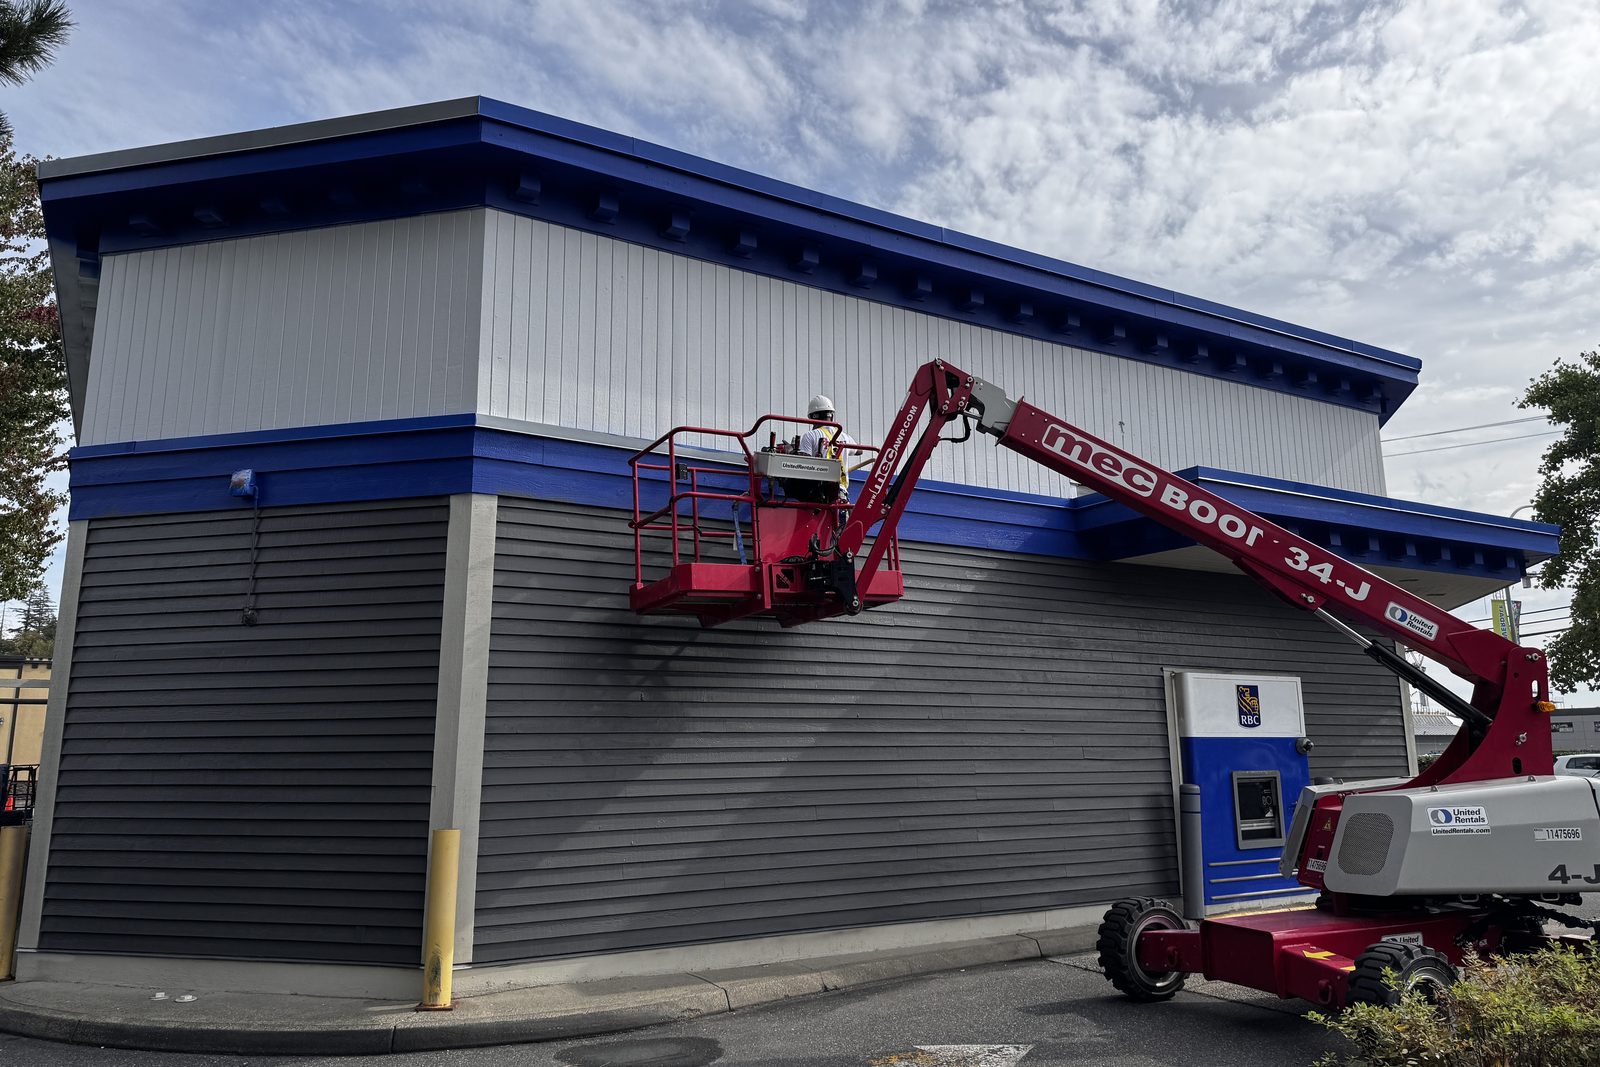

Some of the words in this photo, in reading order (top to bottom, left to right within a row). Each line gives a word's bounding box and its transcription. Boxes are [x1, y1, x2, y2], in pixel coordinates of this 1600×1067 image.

[782, 462, 829, 472] UnitedRentals.com
[1284, 546, 1372, 601] 34-J
[1409, 614, 1434, 630] United
[1406, 620, 1433, 637] Rentals
[1240, 715, 1260, 725] RBC
[1453, 808, 1481, 816] United
[1454, 815, 1486, 824] Rentals
[1432, 827, 1491, 835] UnitedRentals.com
[1545, 829, 1581, 840] 11475696
